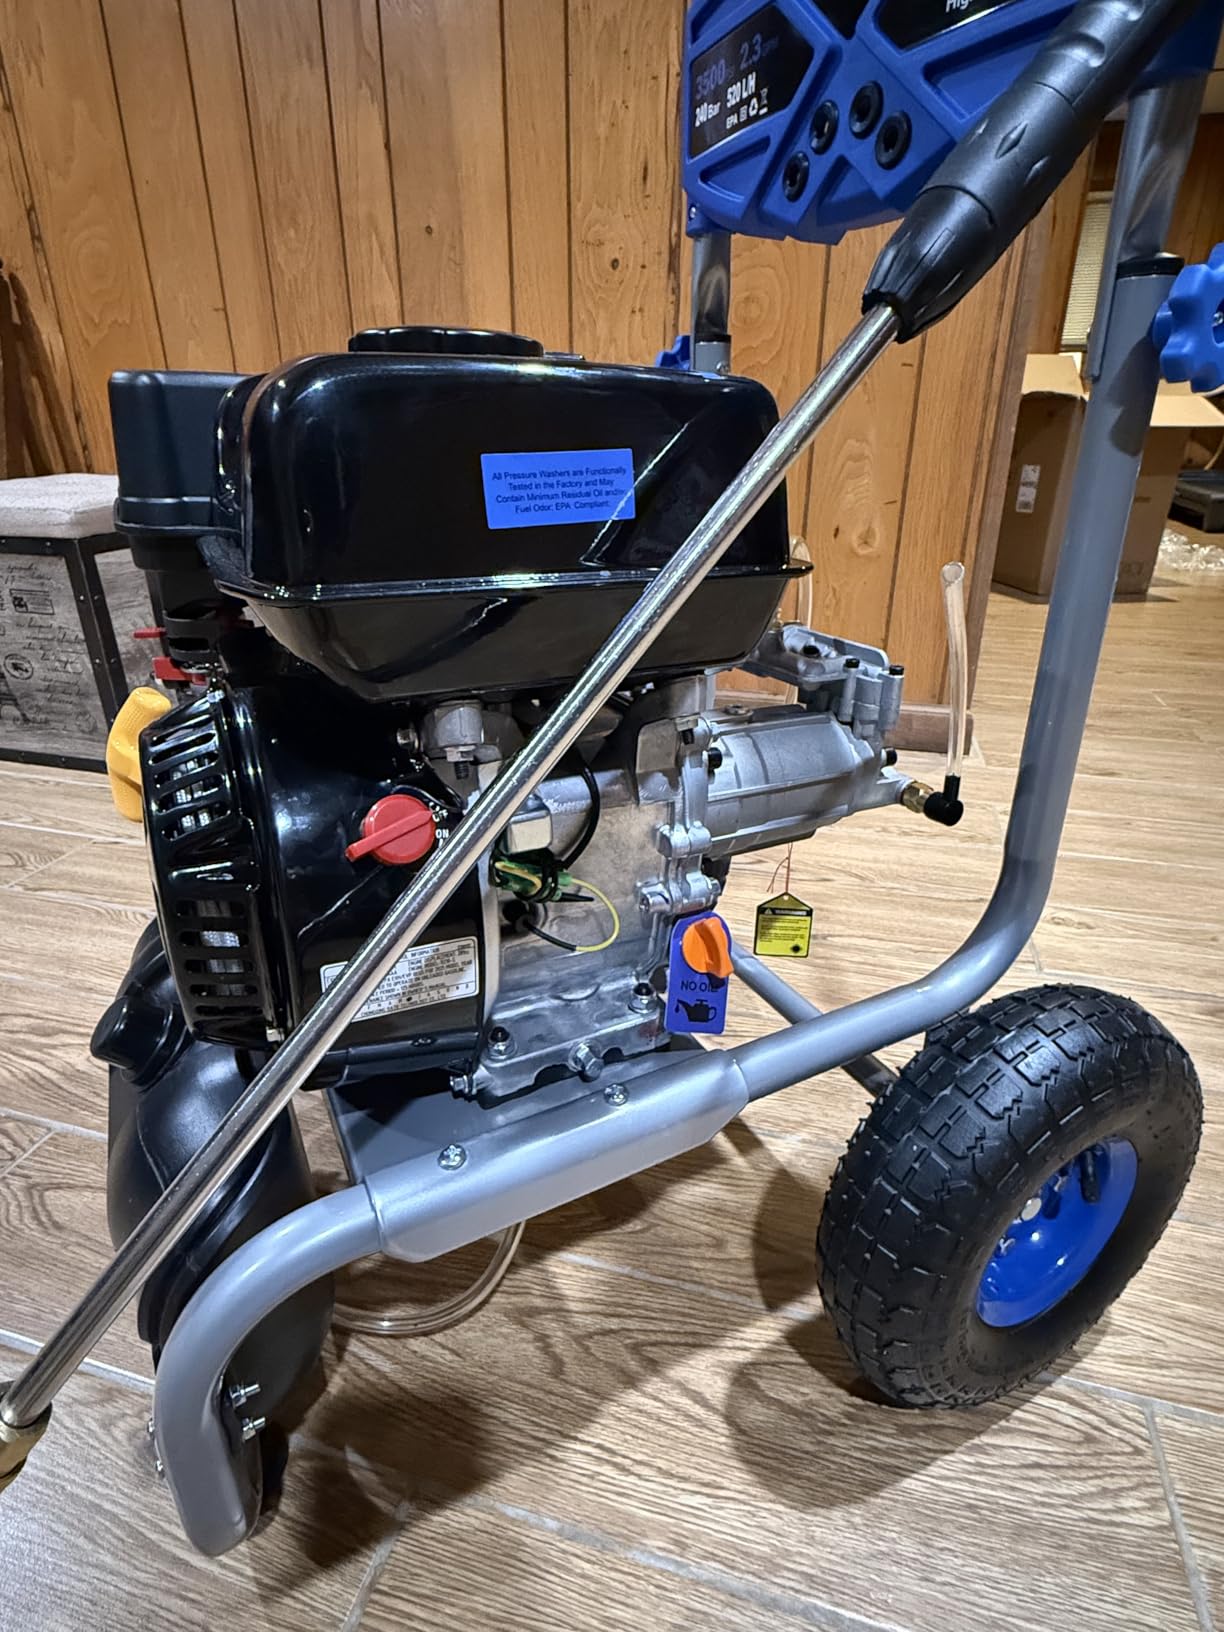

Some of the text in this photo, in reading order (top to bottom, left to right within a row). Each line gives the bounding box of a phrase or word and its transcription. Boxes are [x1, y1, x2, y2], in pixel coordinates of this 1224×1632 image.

[740, 33, 762, 70] 2.3
[696, 58, 726, 100] 3500
[726, 81, 741, 108] 520
[708, 101, 721, 119] Bar
[726, 112, 739, 129] EPA
[492, 472, 502, 480] All
[504, 471, 538, 480] Pressure
[538, 469, 570, 479] Washers
[586, 467, 626, 477] Functionally
[508, 478, 615, 490] Tested in the Factory and May
[495, 494, 526, 503] Contain
[526, 492, 560, 502] Minimum
[561, 490, 592, 499] Residual
[593, 488, 603, 497] Oil
[515, 503, 531, 514] Fuel
[555, 502, 571, 511] EPA
[435, 828, 449, 839] ON
[681, 980, 718, 992] NO OIL
